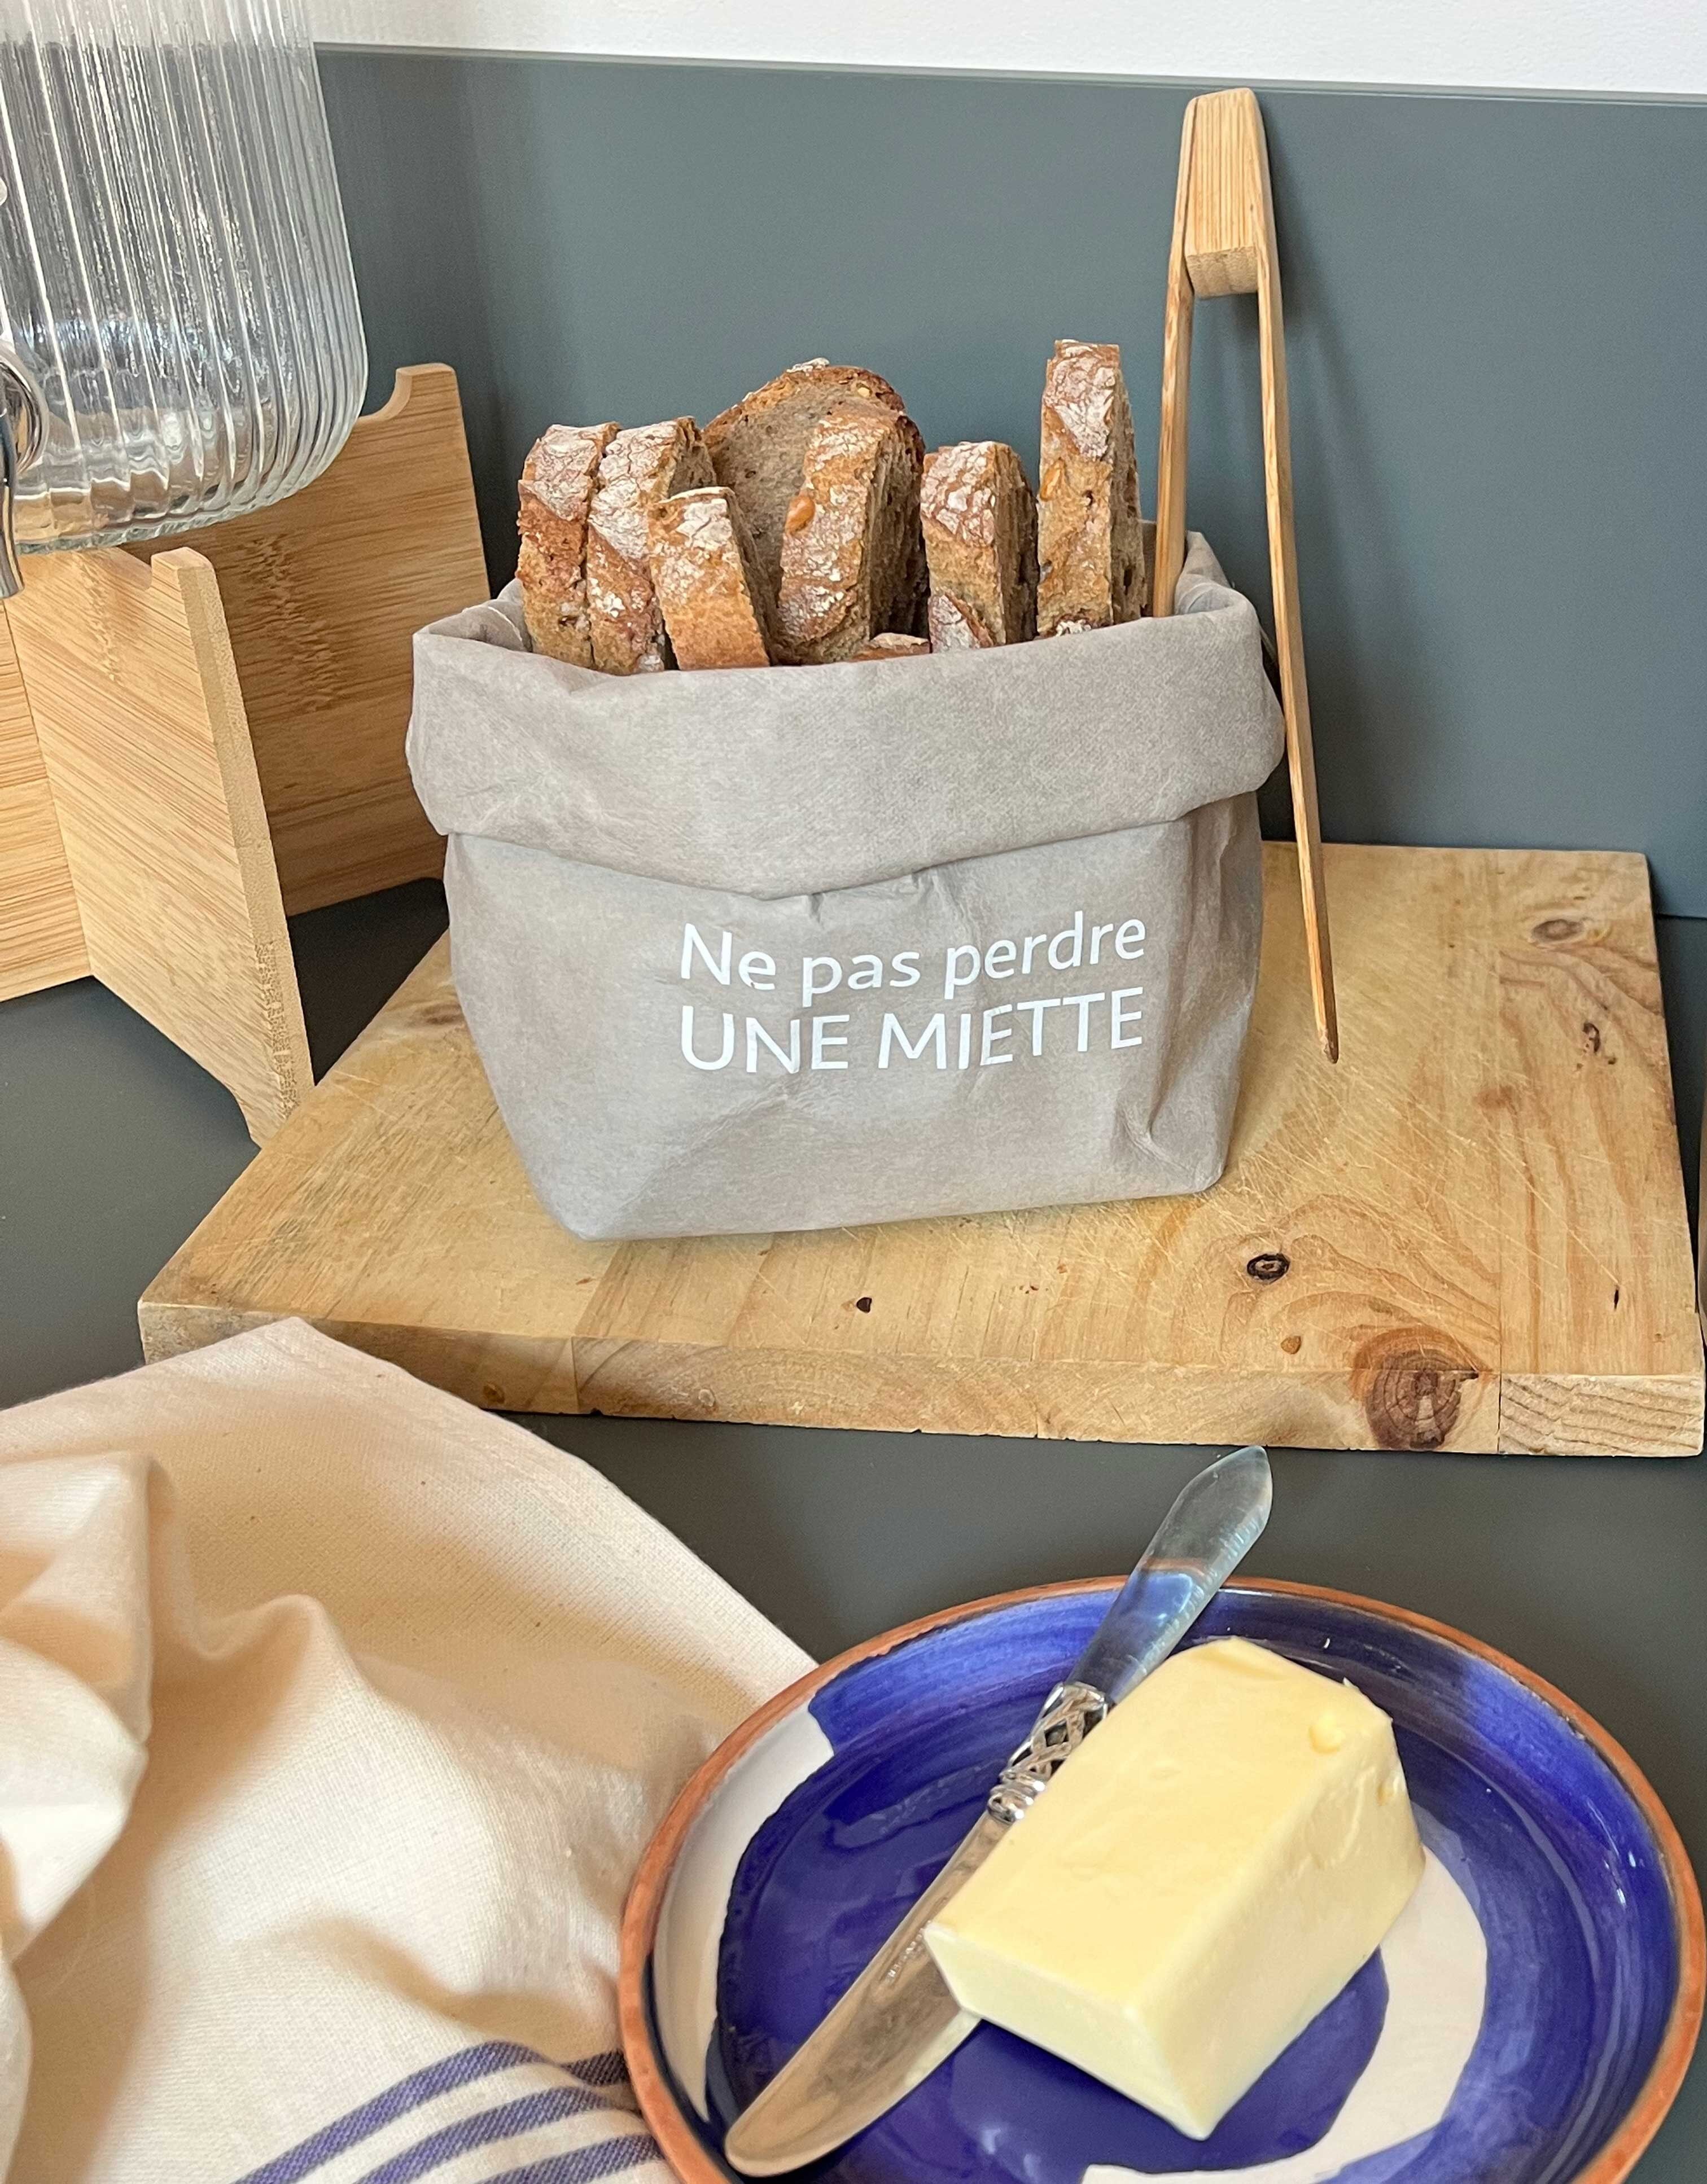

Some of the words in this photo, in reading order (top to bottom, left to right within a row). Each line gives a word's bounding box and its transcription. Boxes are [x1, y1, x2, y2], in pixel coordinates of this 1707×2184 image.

[681, 923, 776, 990] Ne
[802, 951, 921, 1007] pas
[944, 910, 1145, 1000] perdre
[681, 1005, 850, 1074] UNE
[878, 986, 1143, 1071] MIETTE
